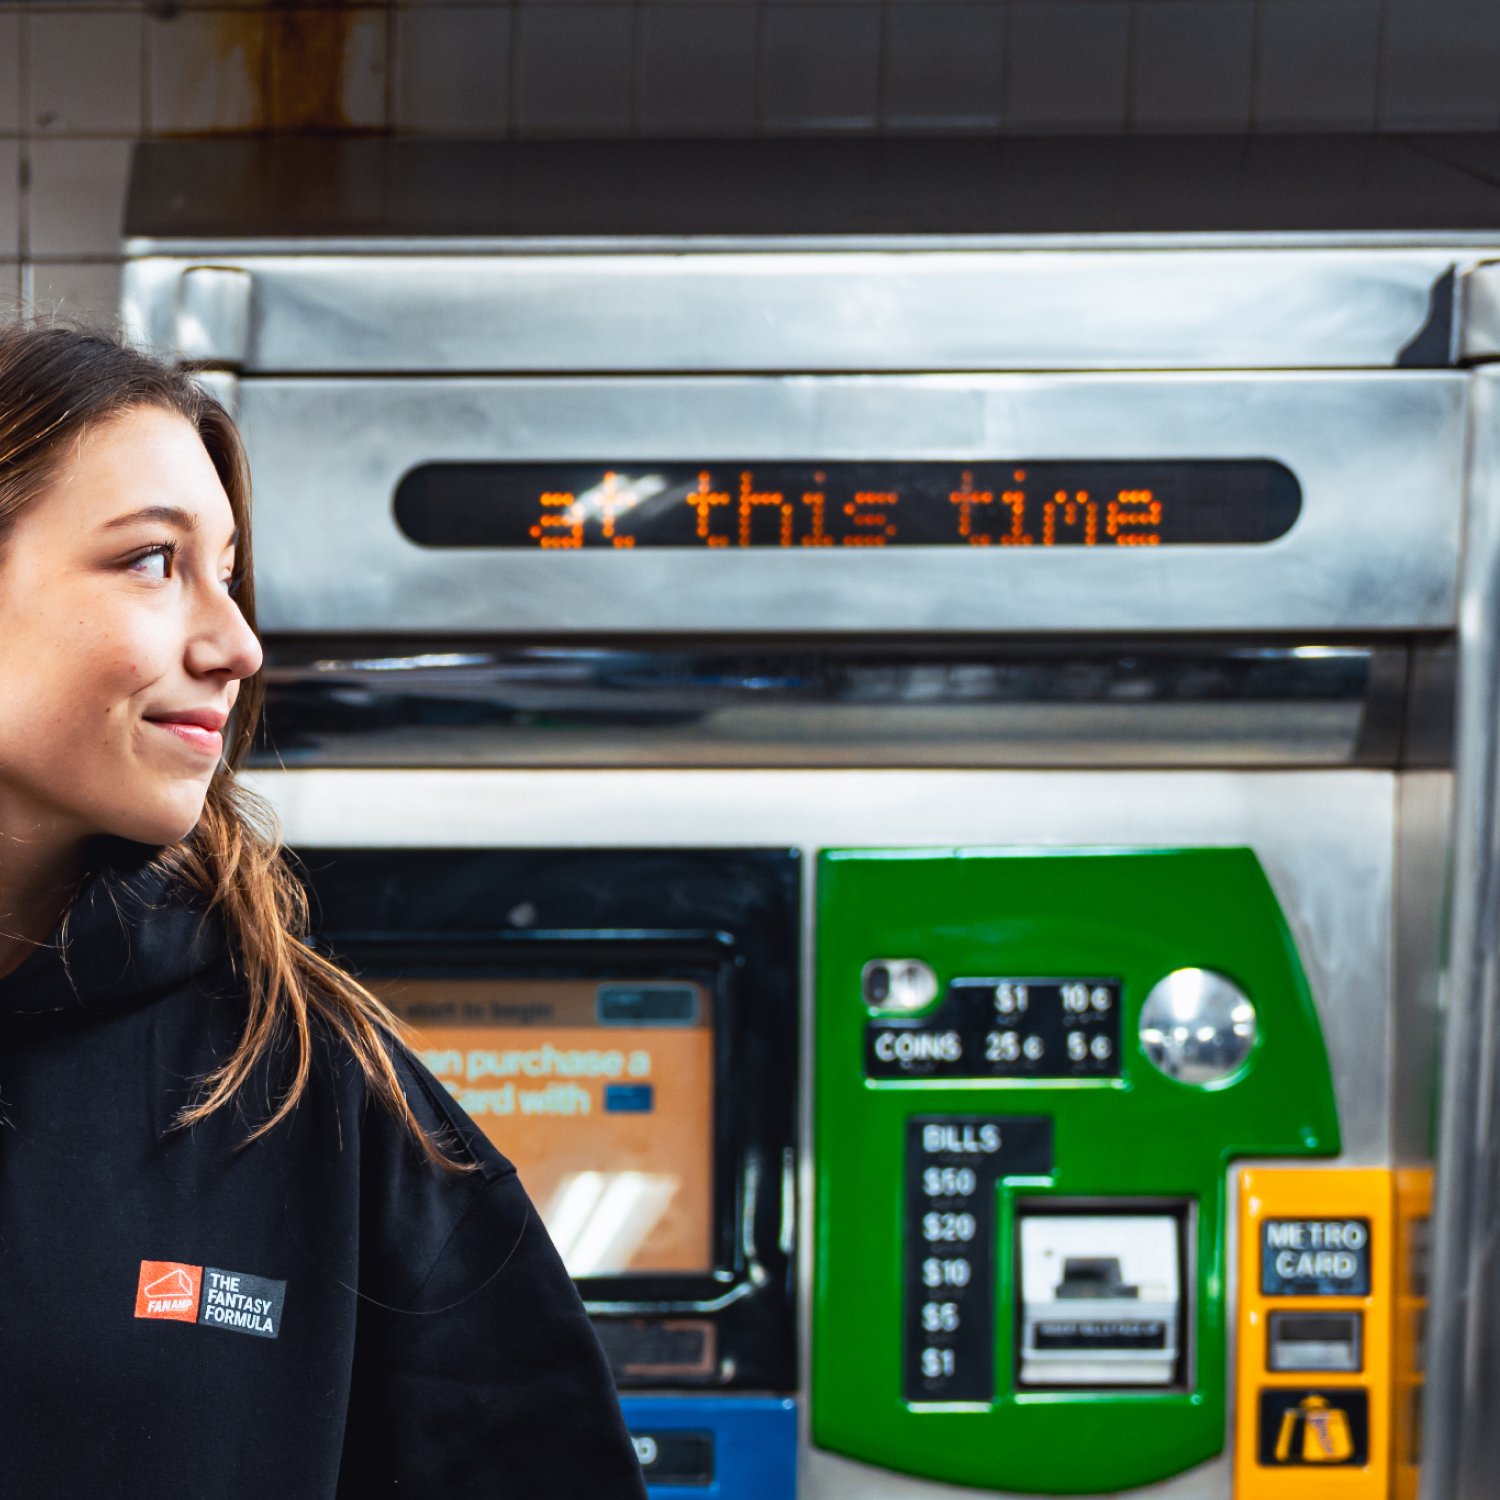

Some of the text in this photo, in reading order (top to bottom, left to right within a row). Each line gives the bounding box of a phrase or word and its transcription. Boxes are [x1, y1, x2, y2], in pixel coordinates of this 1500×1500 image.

[530, 470, 1163, 547] at this time
[995, 983, 1028, 1014] $1
[875, 1031, 963, 1062] COINS
[466, 1043, 624, 1082] purchase
[628, 1050, 651, 1077] a
[518, 1083, 591, 1115] with
[922, 1124, 1001, 1153] BILLS
[922, 1166, 977, 1196] $50
[922, 1213, 977, 1242] $20
[1266, 1221, 1368, 1250] METRO
[922, 1258, 972, 1287] $10
[1275, 1250, 1358, 1279] CARD
[209, 1272, 241, 1293] THE
[207, 1288, 273, 1316] FANTASY
[204, 1304, 274, 1333] FORMULA
[921, 1302, 960, 1332] $5
[921, 1347, 955, 1378] $1
